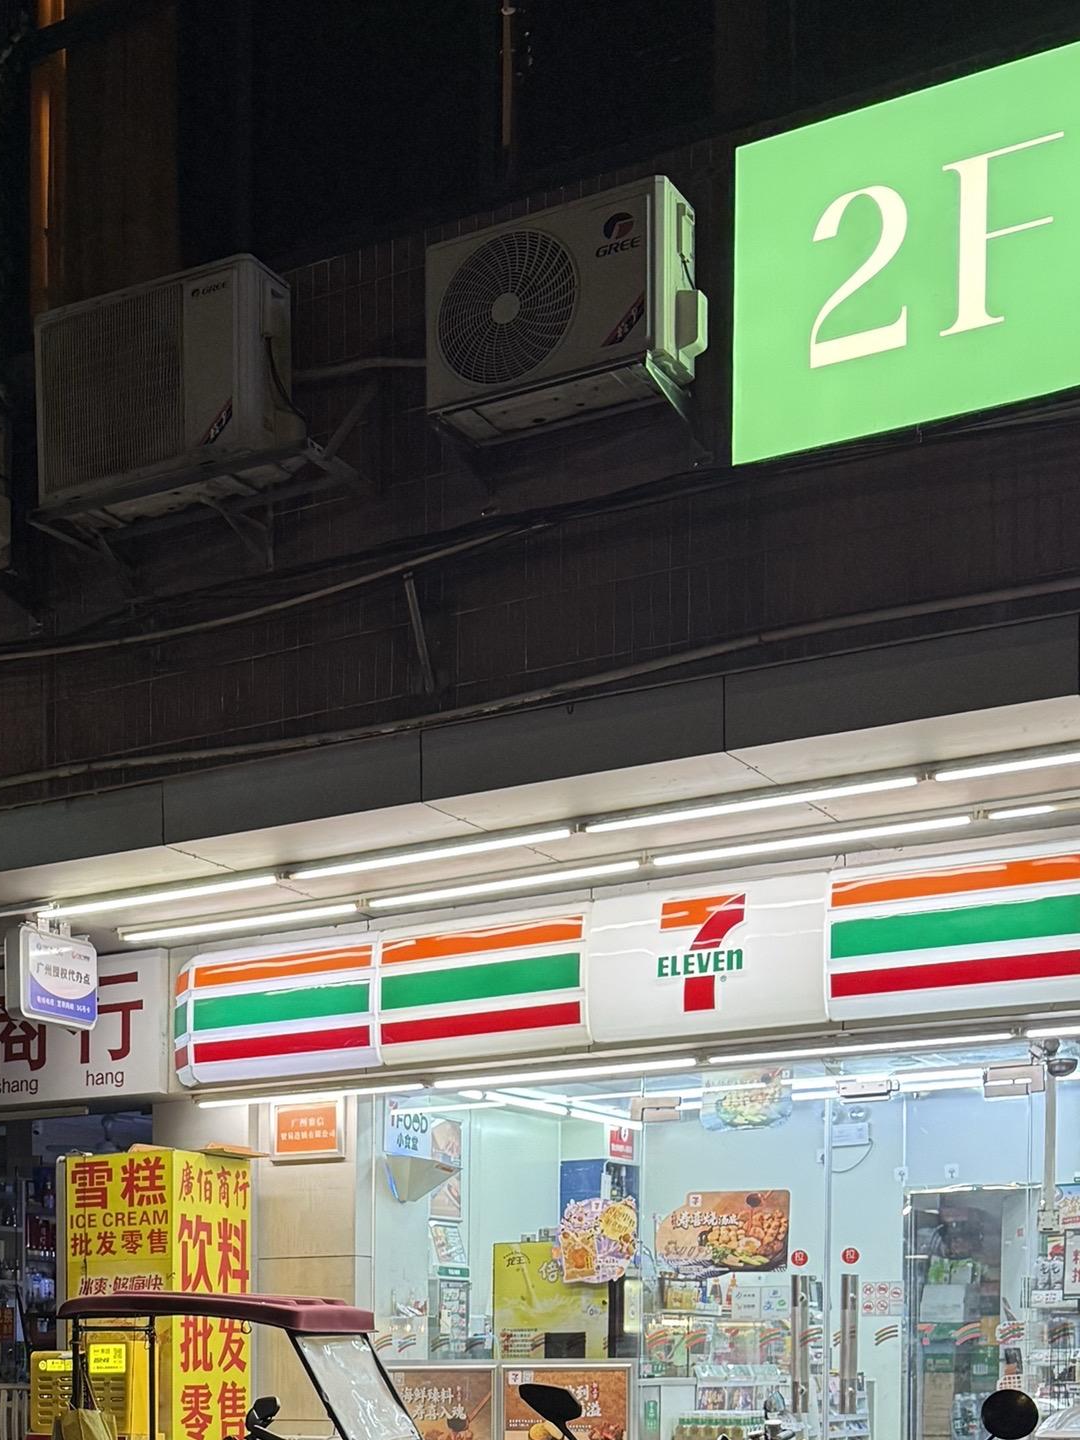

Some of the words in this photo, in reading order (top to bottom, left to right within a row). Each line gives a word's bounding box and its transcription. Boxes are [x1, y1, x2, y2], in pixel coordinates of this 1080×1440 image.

[595, 235, 641, 258] GREE
[810, 131, 1066, 370] 2F
[85, 1069, 125, 1088] hang
[396, 1132, 419, 1151] 小食堂
[71, 1157, 167, 1210] 雪糕
[178, 1161, 250, 1210] 廣佰商行
[70, 1212, 97, 1230] ICE
[102, 1209, 169, 1227] CREAM
[70, 1229, 169, 1257] 批发零售
[178, 1213, 250, 1294] 饮料
[180, 1315, 248, 1373] 批发
